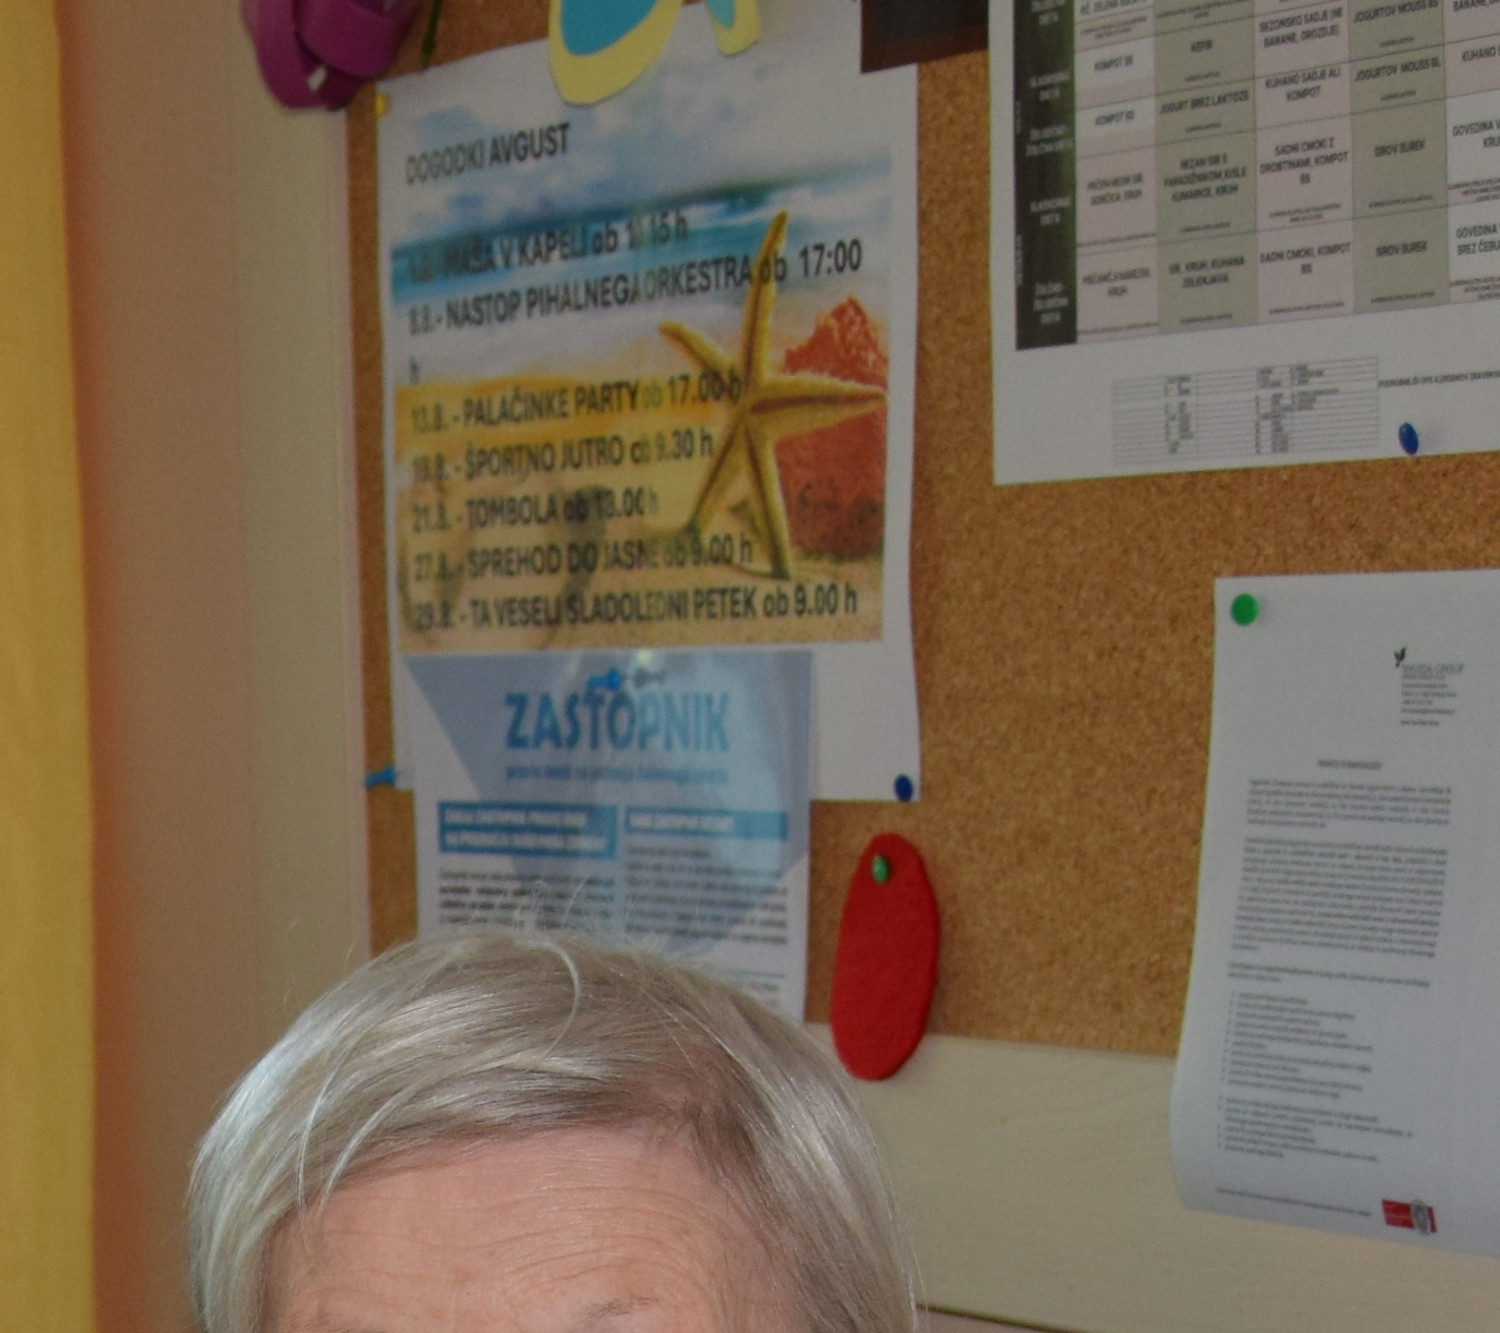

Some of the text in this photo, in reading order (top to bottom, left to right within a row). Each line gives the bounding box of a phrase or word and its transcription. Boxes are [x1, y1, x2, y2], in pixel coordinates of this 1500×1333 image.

[1461, 46, 1496, 62] KUHANO
[1452, 120, 1493, 137] GOVEDINA
[407, 122, 570, 184] DOGODKI AVGUST
[501, 237, 515, 270] V
[592, 219, 618, 254] ob
[675, 207, 688, 240] h
[1456, 223, 1498, 239] GOVEDINA
[446, 239, 862, 329] NASTOP PIHALNEGA ORKESTRA ob 17:00
[463, 384, 569, 426] PALAČINKE
[574, 379, 640, 417] PARTY
[465, 441, 555, 481] ŠPORTNO
[561, 435, 624, 470] JUTRO
[701, 426, 714, 458] h
[466, 493, 559, 530] TOMBOLA
[467, 542, 561, 580] SPREHOD
[567, 540, 598, 574] DO
[740, 532, 753, 563] h
[471, 599, 492, 628] TA
[567, 588, 687, 627] SLADOLEDNI
[694, 585, 757, 620] PETEK
[764, 584, 788, 617] ob
[794, 582, 838, 616] 9.00
[846, 580, 858, 614] h
[506, 690, 728, 750] ZASTOPNIK
